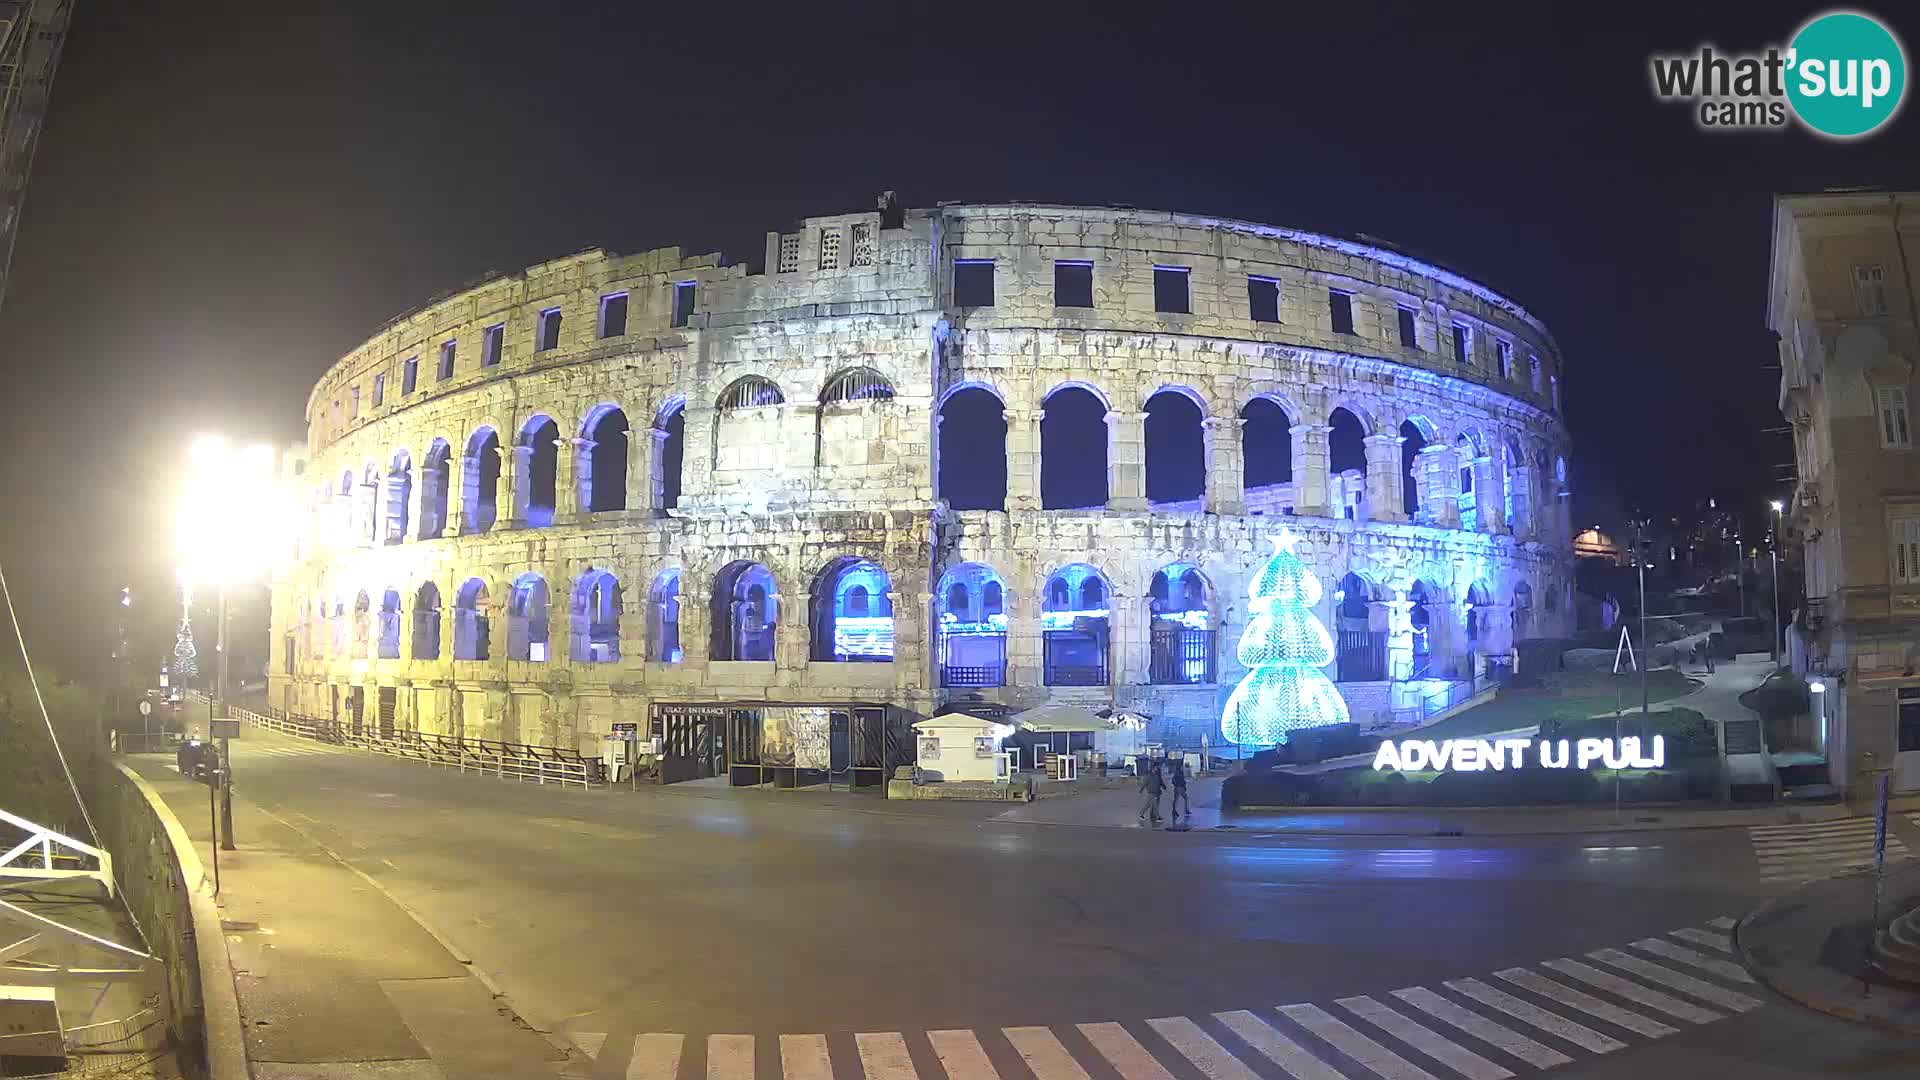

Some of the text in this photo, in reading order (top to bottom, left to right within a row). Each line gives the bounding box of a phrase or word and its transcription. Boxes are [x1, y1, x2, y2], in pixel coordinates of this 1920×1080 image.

[688, 706, 724, 715] ENTRANCE
[1372, 735, 1665, 771] ADVENT U PULI
